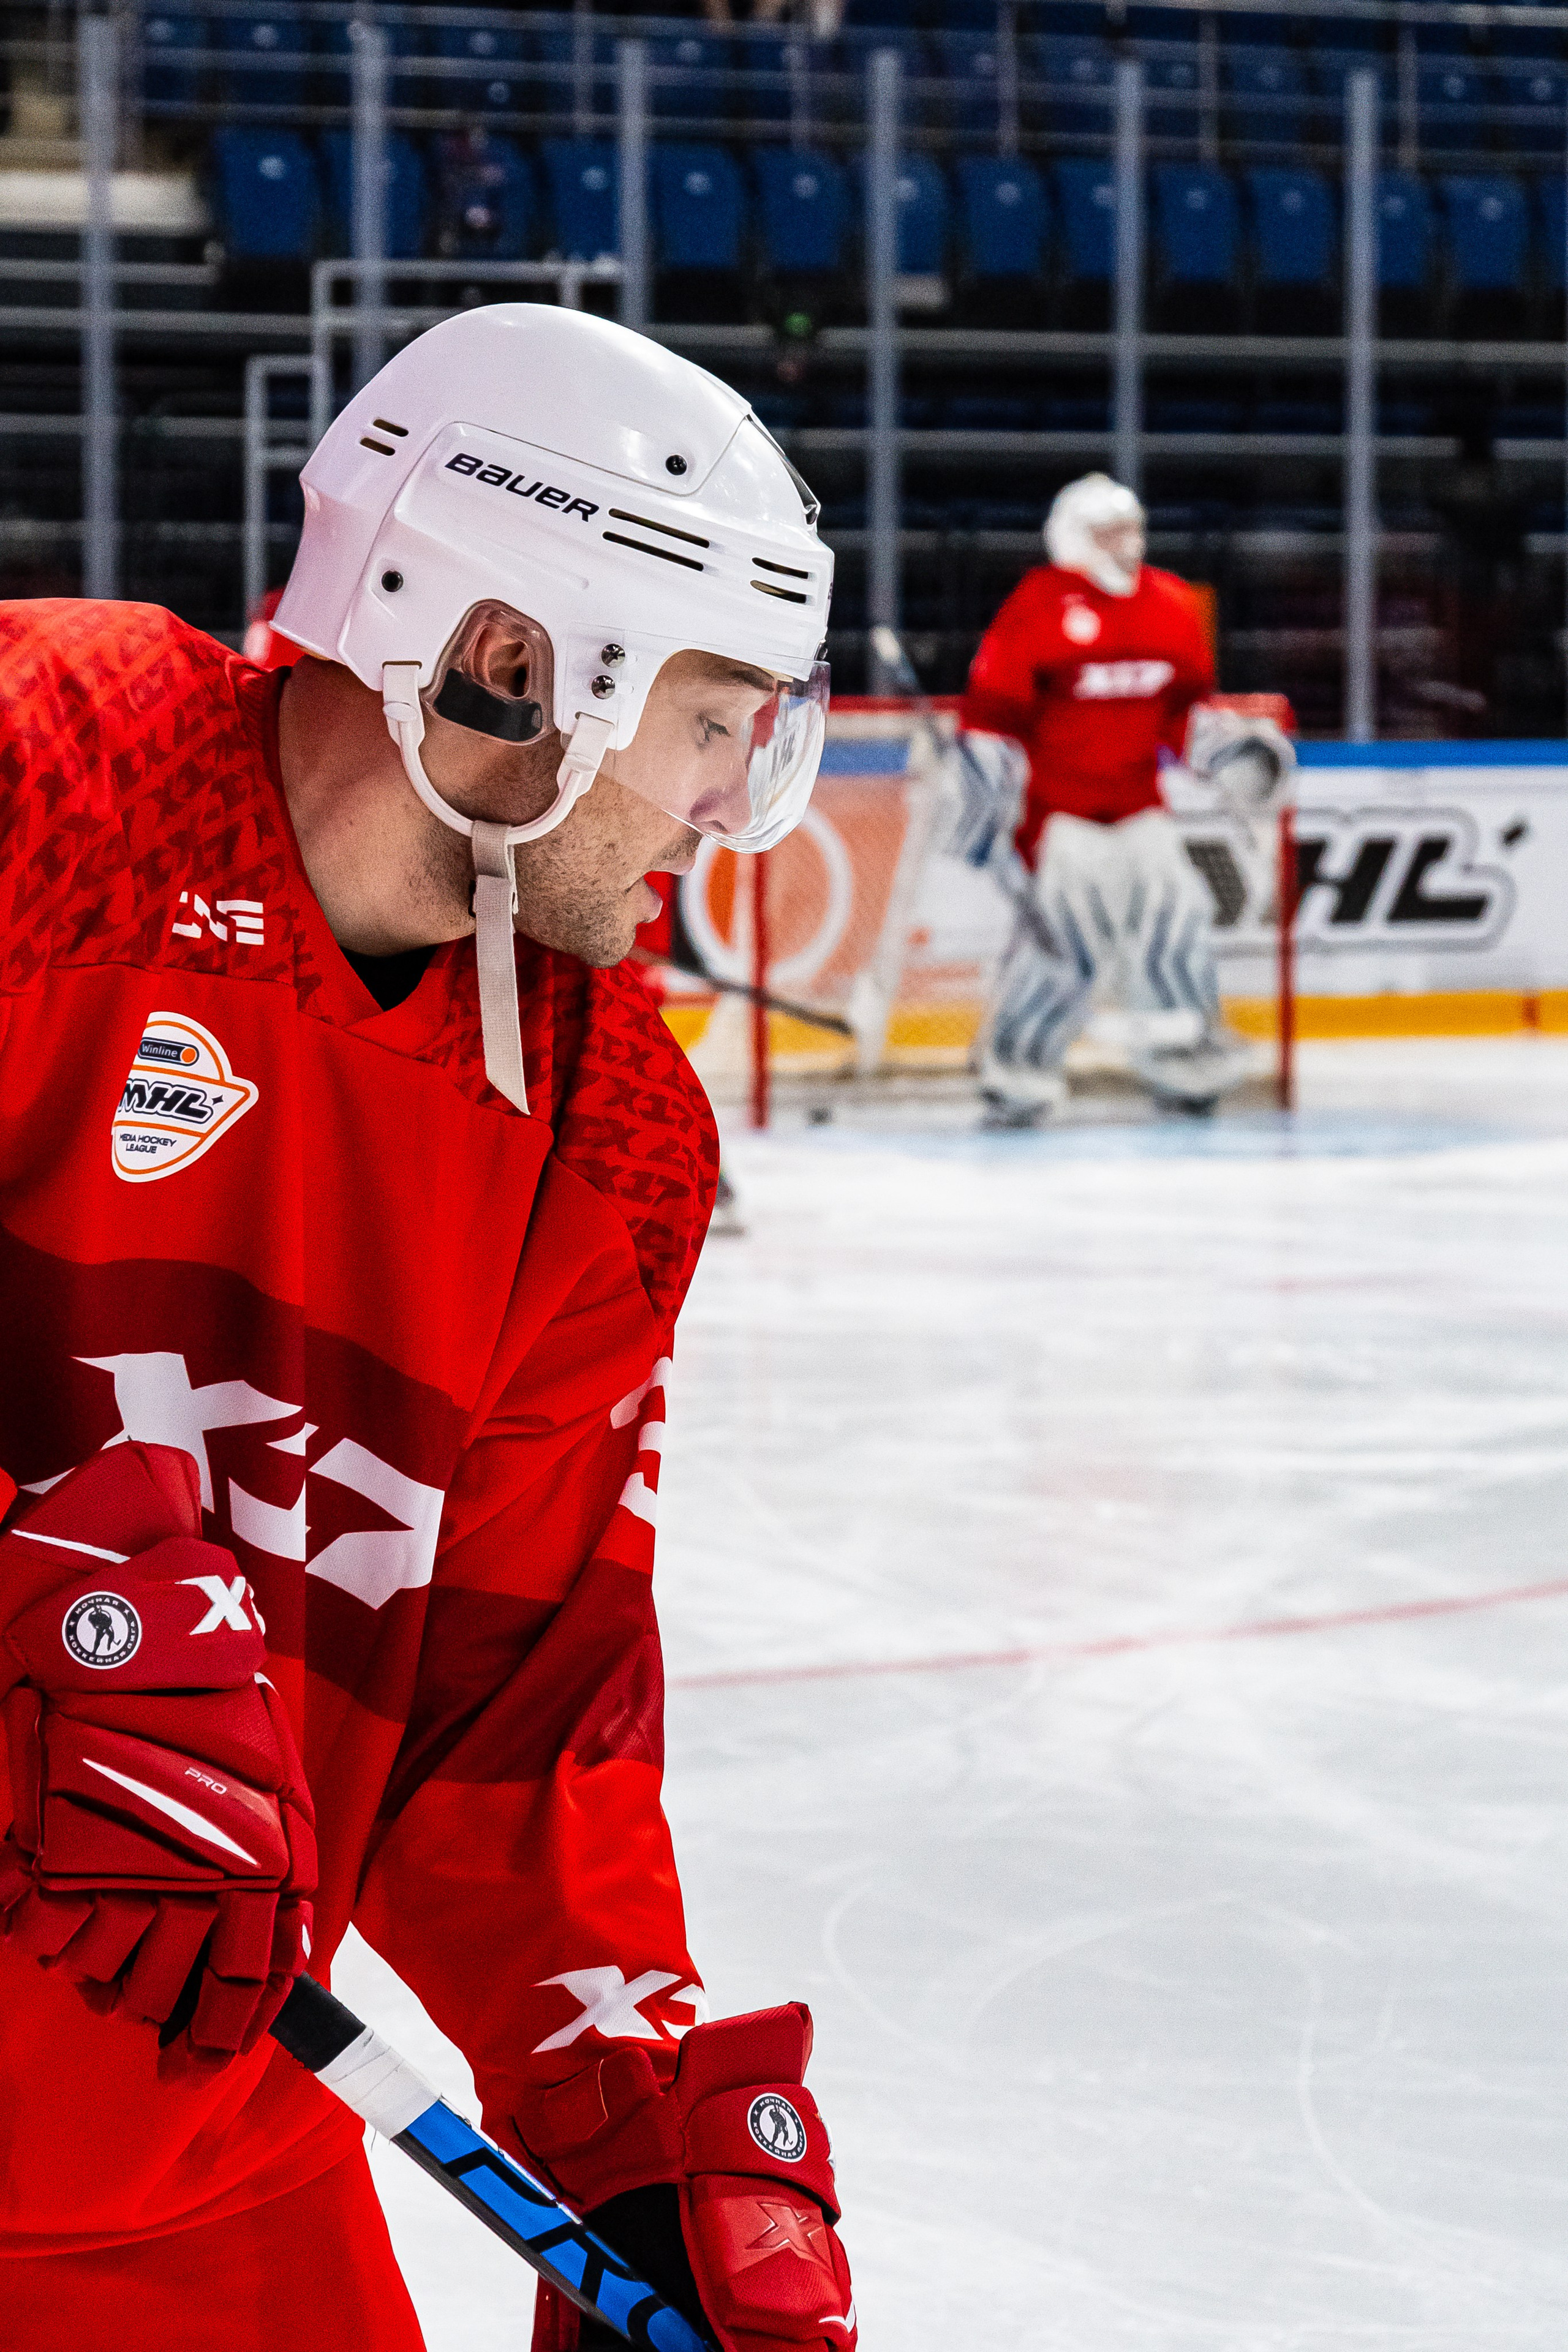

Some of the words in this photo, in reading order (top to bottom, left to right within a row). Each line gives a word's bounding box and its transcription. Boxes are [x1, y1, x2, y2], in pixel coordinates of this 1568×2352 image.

[141, 1044, 178, 1057] Winline
[138, 1135, 176, 1147] HOCKEY
[184, 1767, 227, 1795] PRO
